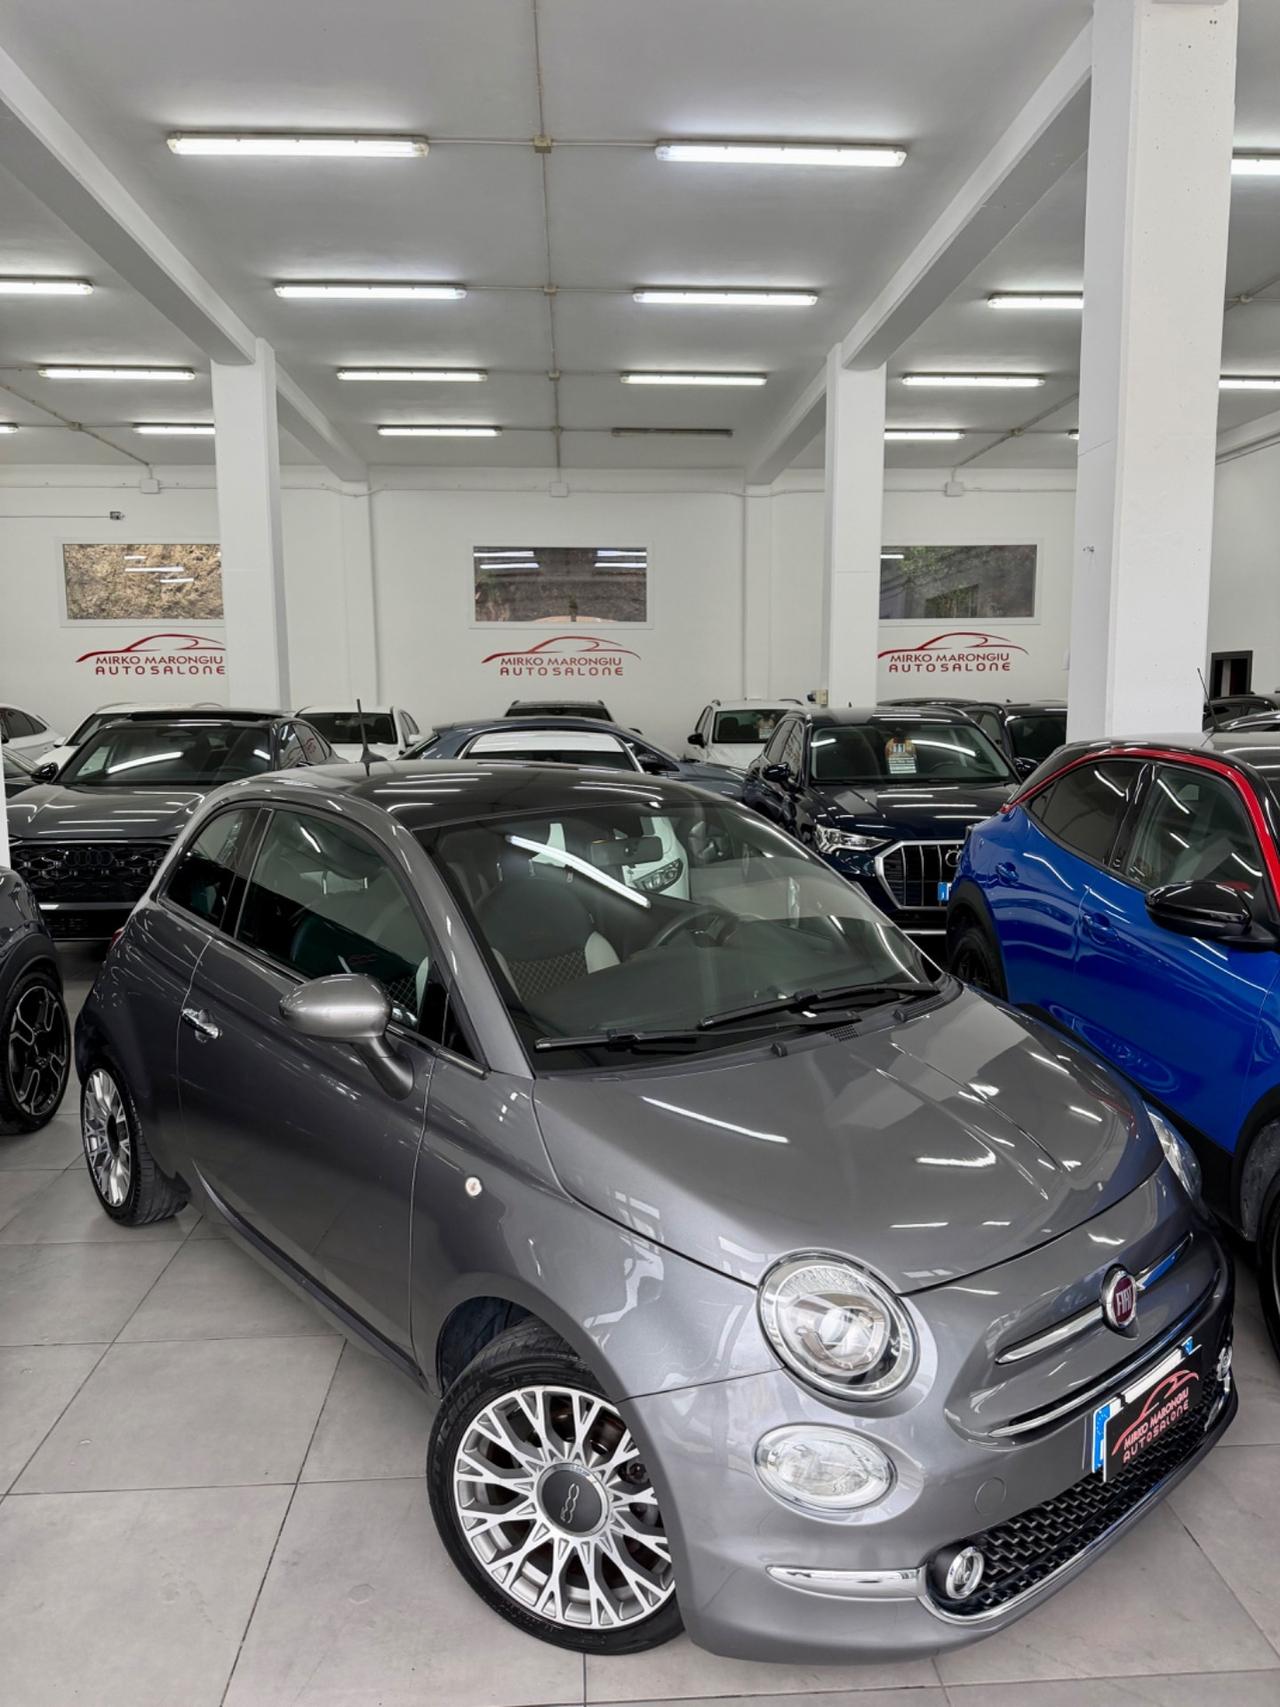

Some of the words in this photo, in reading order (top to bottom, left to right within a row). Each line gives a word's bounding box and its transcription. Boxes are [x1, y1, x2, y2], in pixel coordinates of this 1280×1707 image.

[96, 656, 141, 665] MIRKO
[144, 655, 223, 665] MARONGIU
[500, 657, 544, 666] MIRKO
[547, 657, 622, 666] MARONGIU
[890, 653, 932, 663] MIRKO
[936, 653, 1009, 663] MARONGIU
[95, 665, 226, 675] AUTOSALONE
[500, 666, 624, 676] AUTOSALONE
[888, 662, 1011, 673] AUTOSALONE
[1116, 1286, 1132, 1316] FIAT
[1123, 1399, 1189, 1463] AUTOSALONE
